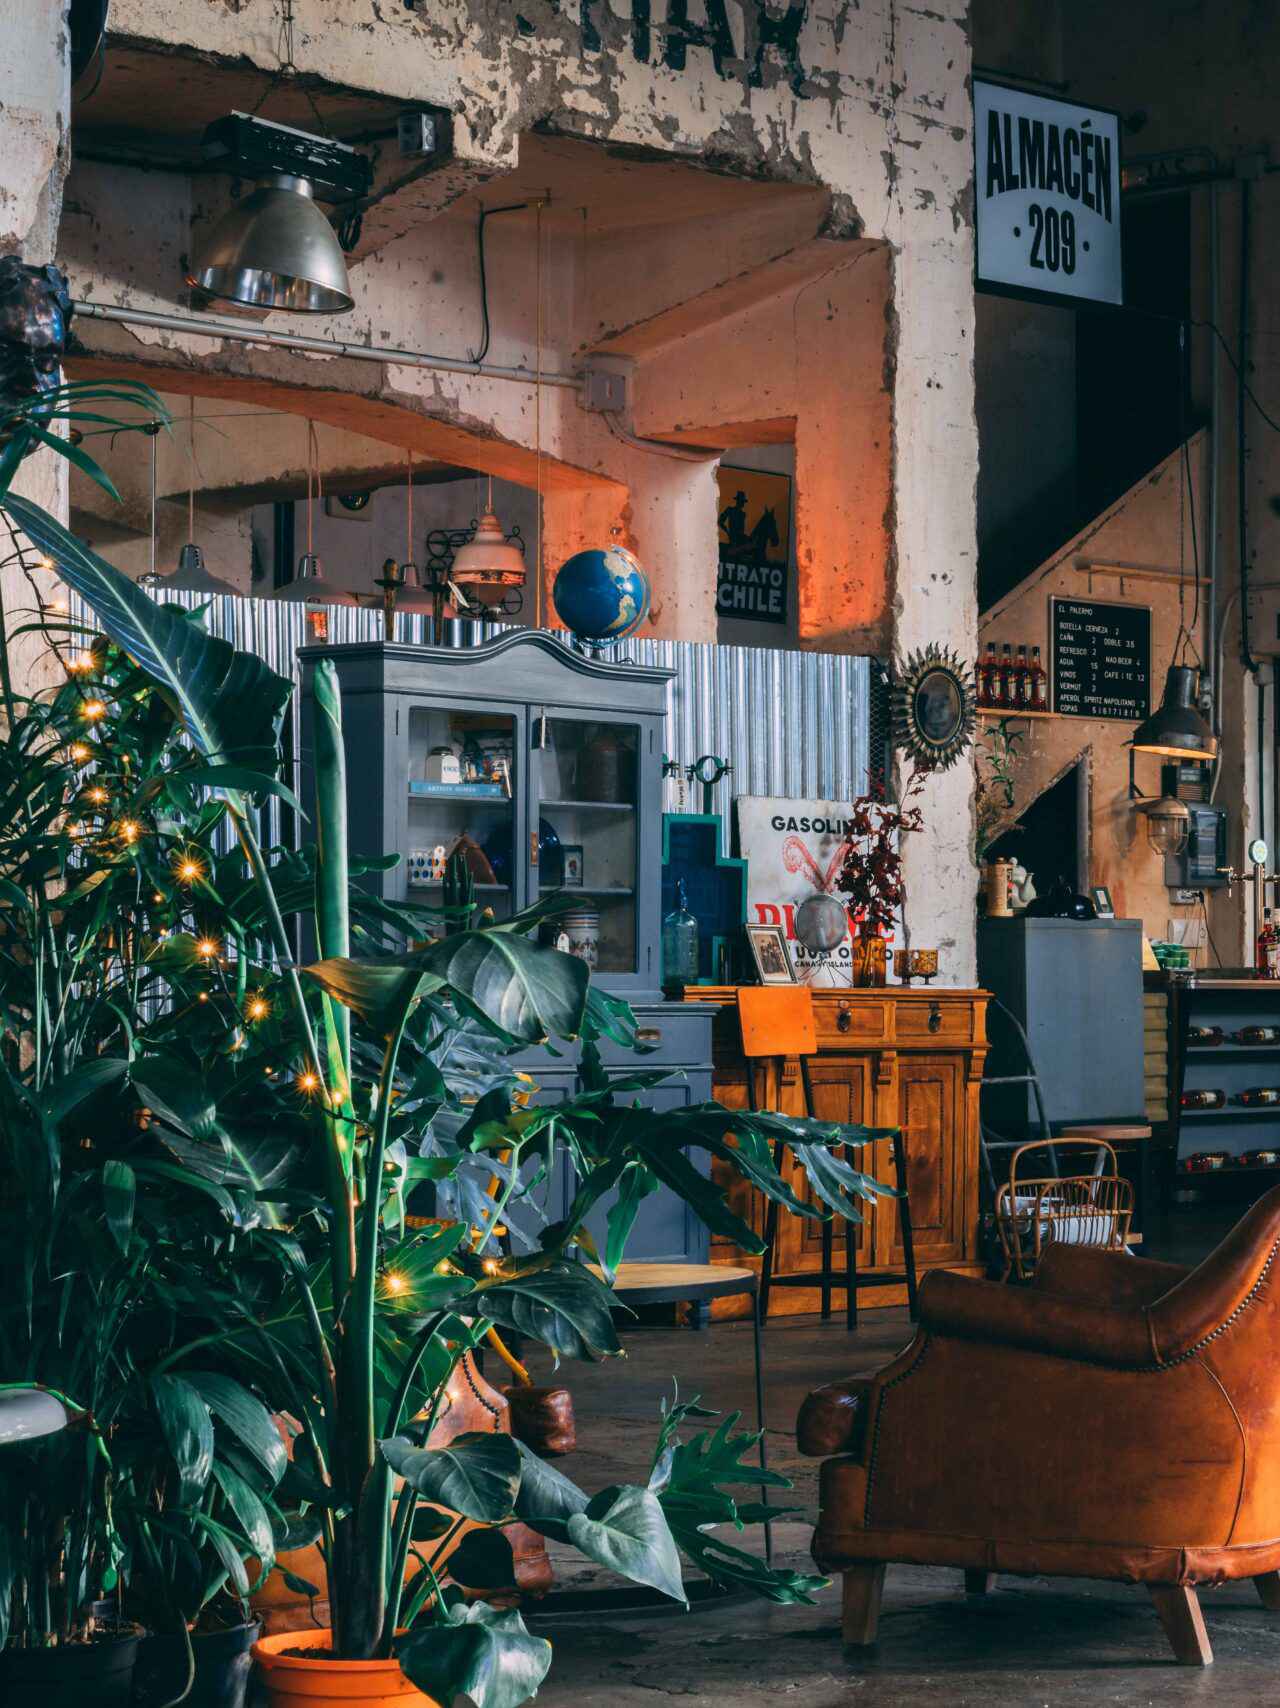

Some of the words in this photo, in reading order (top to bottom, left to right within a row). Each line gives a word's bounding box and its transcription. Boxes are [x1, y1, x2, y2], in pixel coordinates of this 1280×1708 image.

[986, 109, 1112, 224] ALMACÉN
[1028, 203, 1076, 276] 209
[717, 582, 782, 613] CHILE
[1070, 606, 1093, 616] PALERMO
[1059, 622, 1082, 631] BOTELLA
[1085, 625, 1108, 634] CERVEZA
[1103, 638, 1122, 647] DOBLE
[1059, 646, 1088, 656] REFRESCO
[1059, 658, 1074, 666] AGUA
[1059, 671, 1077, 679] VINOS
[1059, 683, 1082, 691] VERMUT
[1059, 694, 1081, 703] APEROL
[1060, 704, 1079, 712] COPAS
